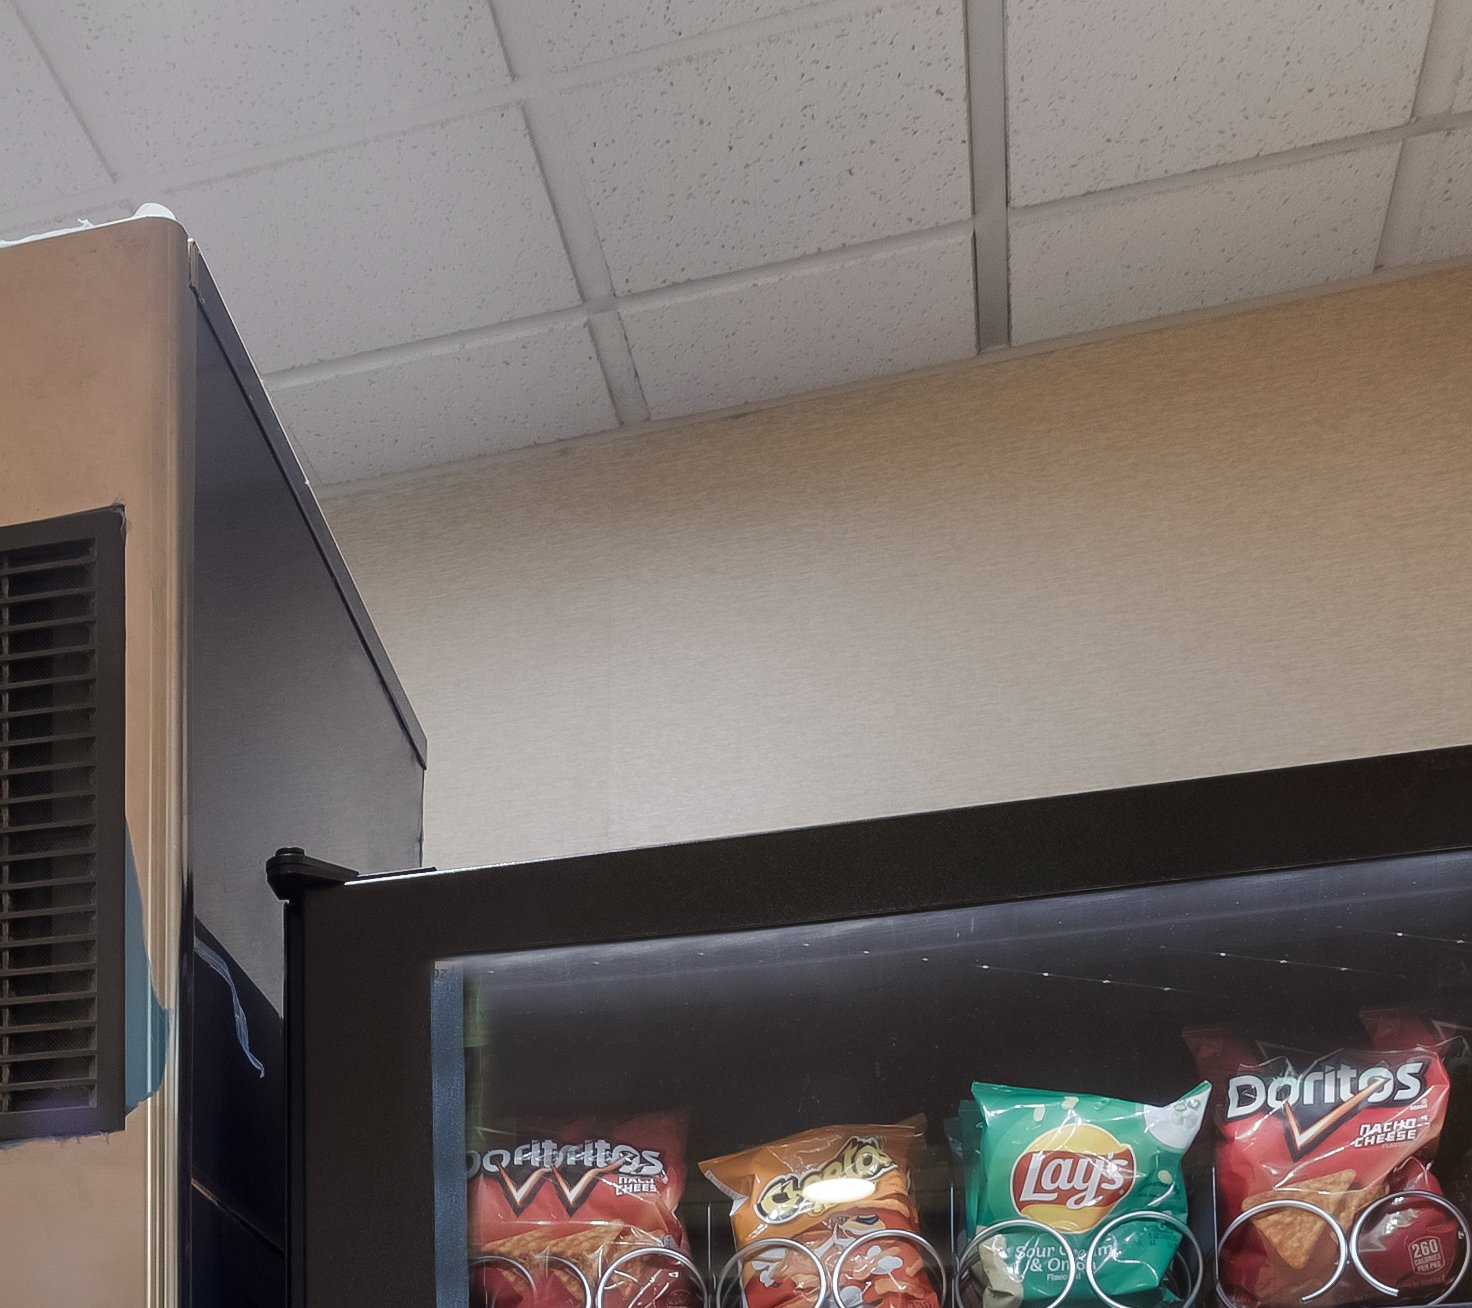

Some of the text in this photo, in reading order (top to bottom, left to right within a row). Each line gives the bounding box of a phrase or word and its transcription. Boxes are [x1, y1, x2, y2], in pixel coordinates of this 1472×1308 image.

[1227, 1062, 1424, 1120] Doritos
[1360, 1117, 1417, 1136] NACHO
[1355, 1130, 1418, 1148] CHEESE
[1020, 1152, 1129, 1210] Lay's
[1411, 1238, 1440, 1258] 260
